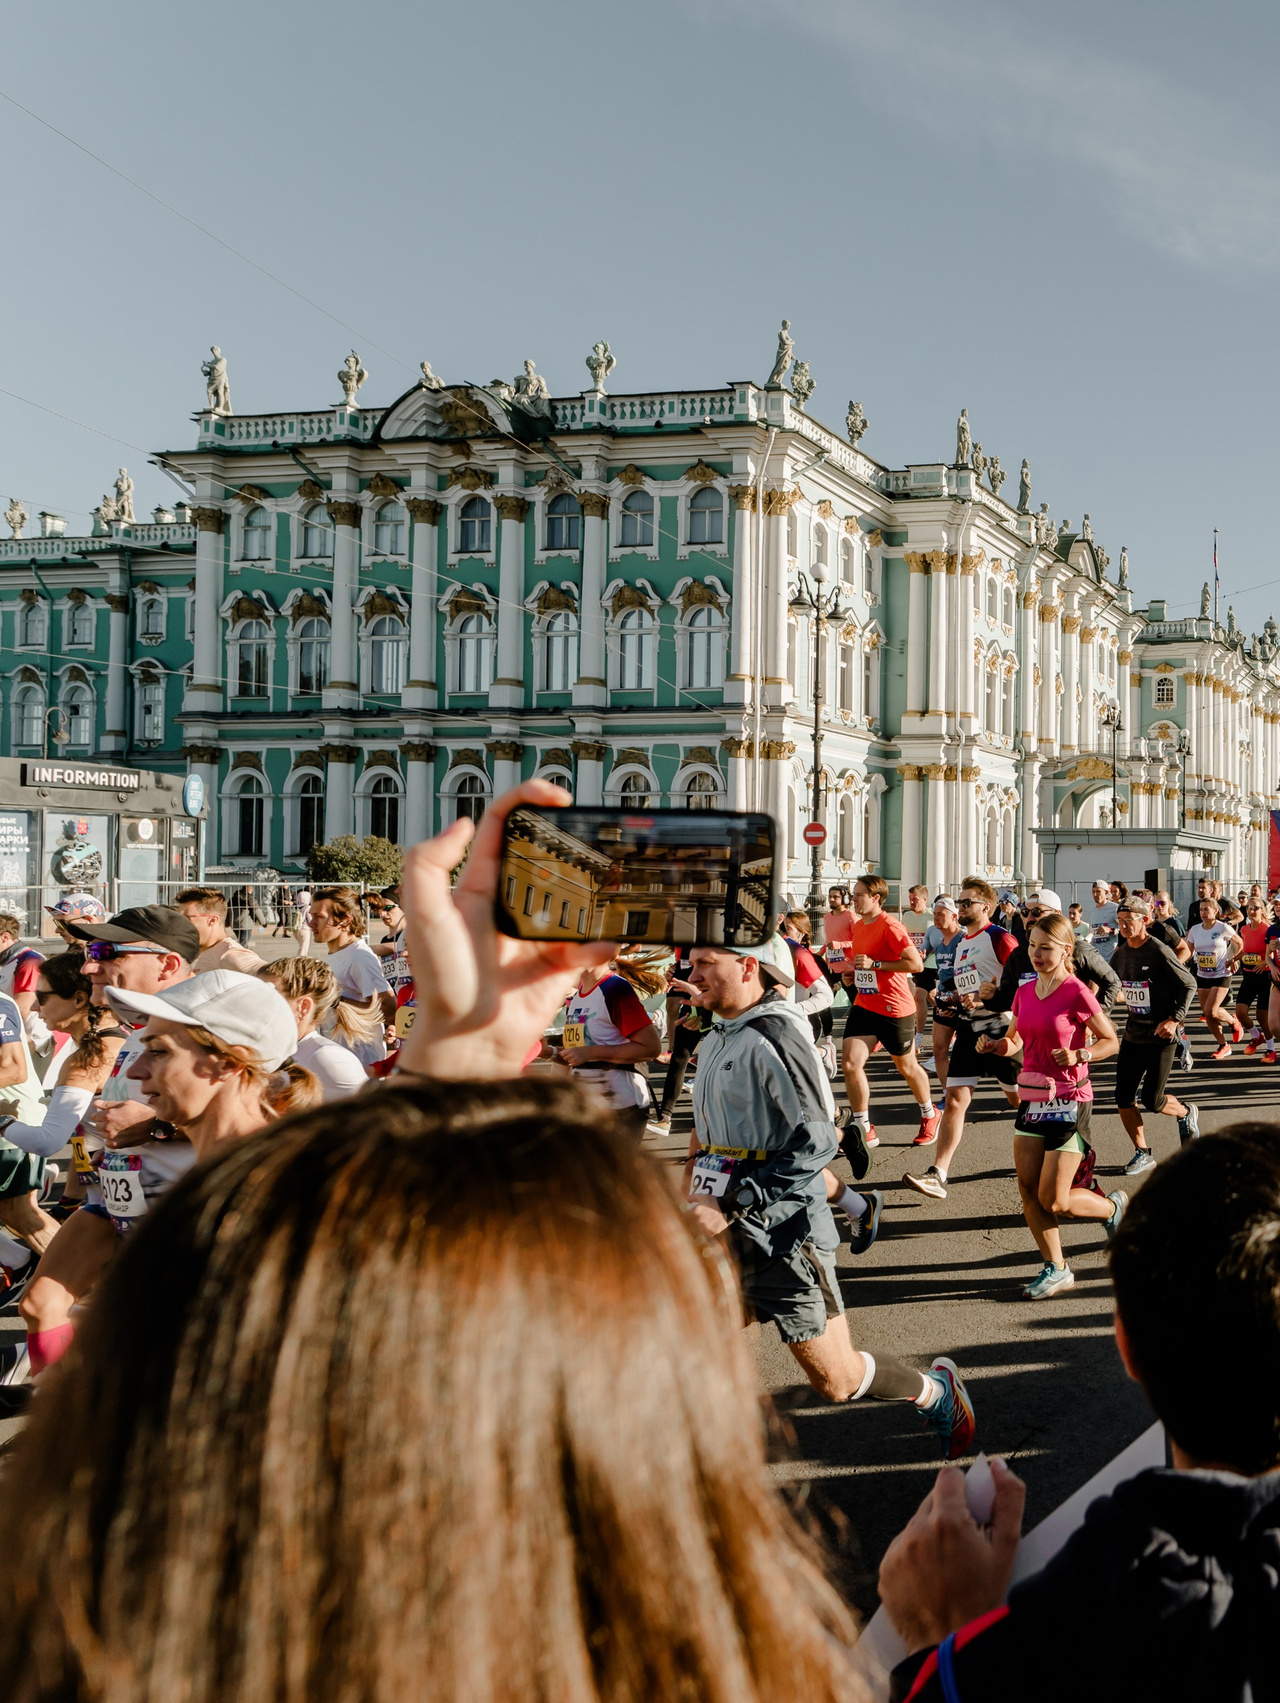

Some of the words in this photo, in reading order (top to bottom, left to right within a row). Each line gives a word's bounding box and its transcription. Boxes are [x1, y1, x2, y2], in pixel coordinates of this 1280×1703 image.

[33, 767, 139, 788] INFORMATION
[1199, 957, 1214, 965] 4816
[856, 972, 874, 983] 4398
[957, 973, 977, 988] 4010
[1126, 990, 1145, 1001] 2710
